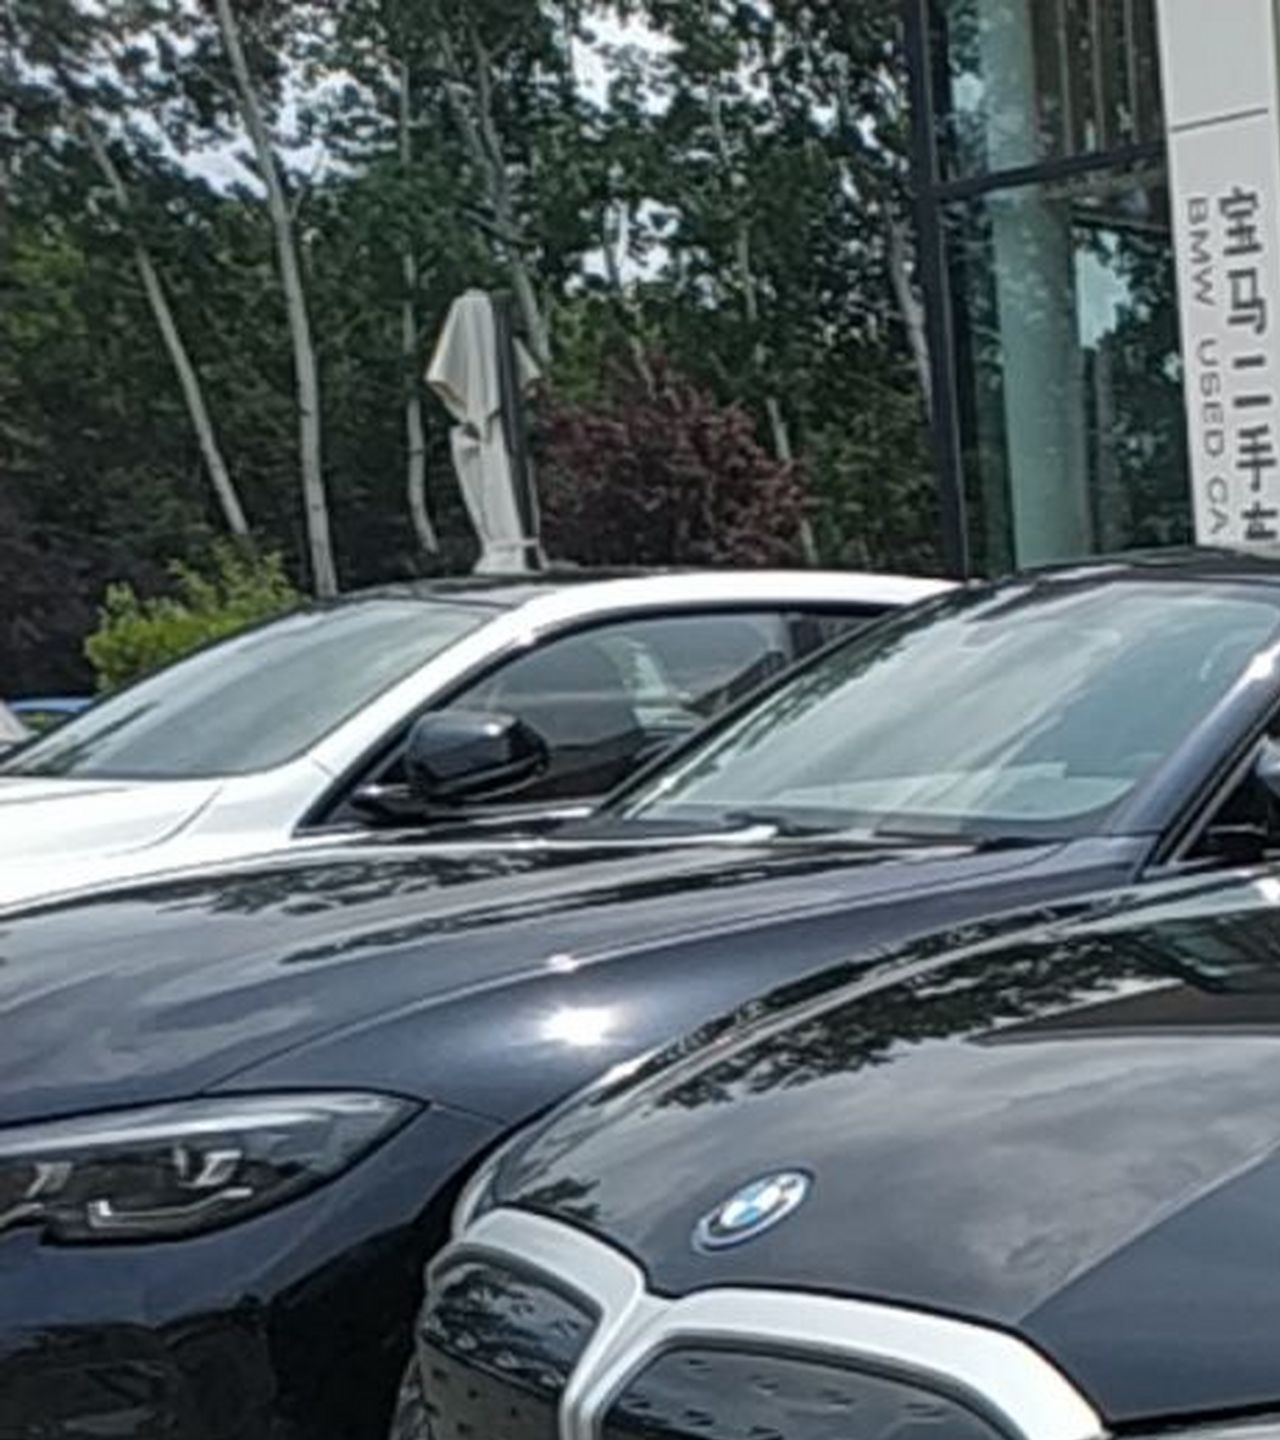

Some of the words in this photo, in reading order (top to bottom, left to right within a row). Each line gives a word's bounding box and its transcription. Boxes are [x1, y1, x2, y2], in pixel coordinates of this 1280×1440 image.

[1187, 196, 1216, 307] BMW
[1198, 338, 1225, 457] USED
[1206, 476, 1231, 535] CA
